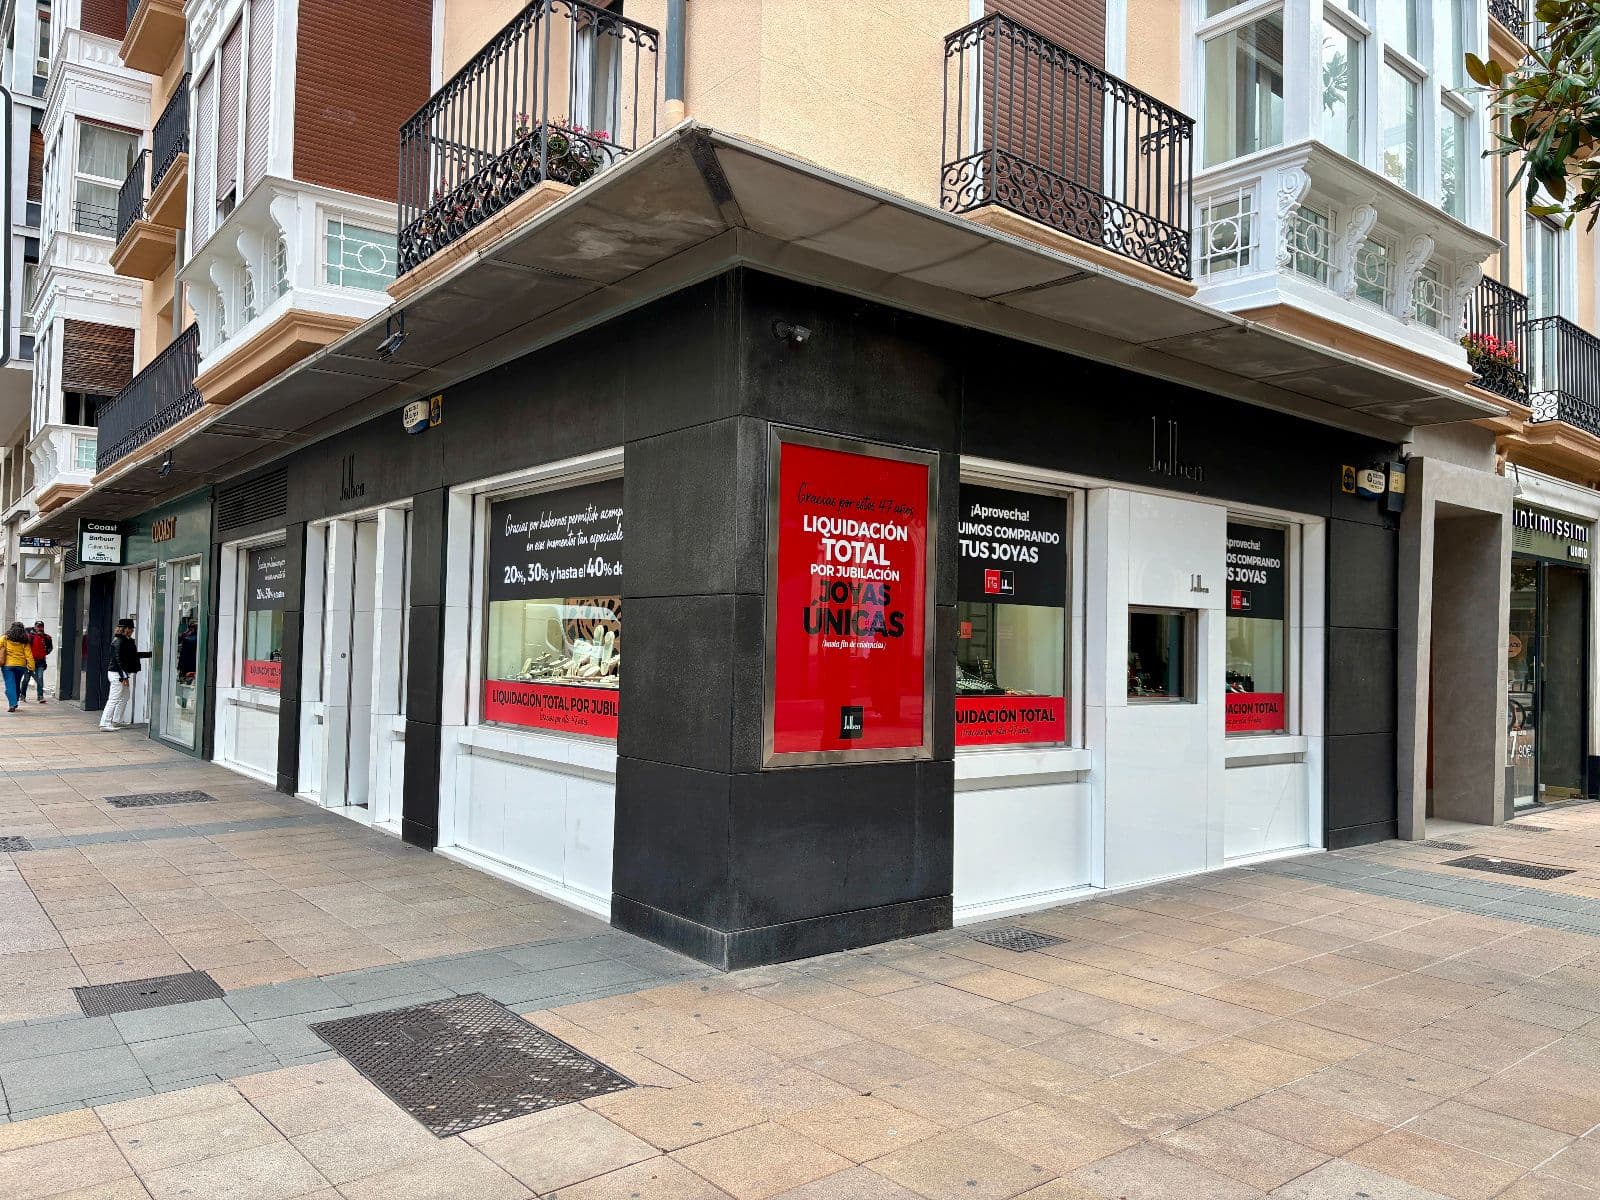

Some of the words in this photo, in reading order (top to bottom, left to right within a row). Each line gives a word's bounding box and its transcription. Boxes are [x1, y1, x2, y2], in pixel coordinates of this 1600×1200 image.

[505, 513, 529, 537] Gracias
[528, 520, 540, 538] por
[540, 510, 568, 529] habernos
[567, 502, 599, 532] permitido
[970, 503, 1030, 521] ¡Aprovecha!
[803, 514, 908, 541] LIQUIDACIÓN
[994, 525, 1060, 545] COMPRANDO
[1515, 508, 1589, 542] intimissimi
[526, 541, 534, 552] en
[546, 529, 577, 550] momentos
[577, 529, 589, 545] tan
[821, 537, 891, 566] TOTAL
[959, 539, 990, 559] TUS
[991, 542, 1039, 564] JOYAS
[504, 564, 526, 585] 20%,
[527, 562, 549, 582] 30%
[550, 569, 556, 583] y
[556, 566, 578, 580] hasta
[578, 563, 586, 578] el
[586, 556, 613, 577] 40%
[810, 563, 835, 577] POR
[836, 565, 900, 582] JUBILACIÓN
[1237, 554, 1281, 569] COMPRANDO
[1235, 568, 1267, 585] JOYAS
[819, 579, 892, 606] JOYAS
[803, 599, 905, 638] ÚNICAS
[492, 689, 541, 708] LIQUIDACIÓN
[543, 694, 569, 711] TOTAL
[570, 697, 590, 713] POR
[591, 699, 618, 717] JUBIL
[955, 705, 1017, 724] UIDACIÓN
[1020, 708, 1056, 723] TOTAL
[1255, 702, 1279, 713] TOTAL
